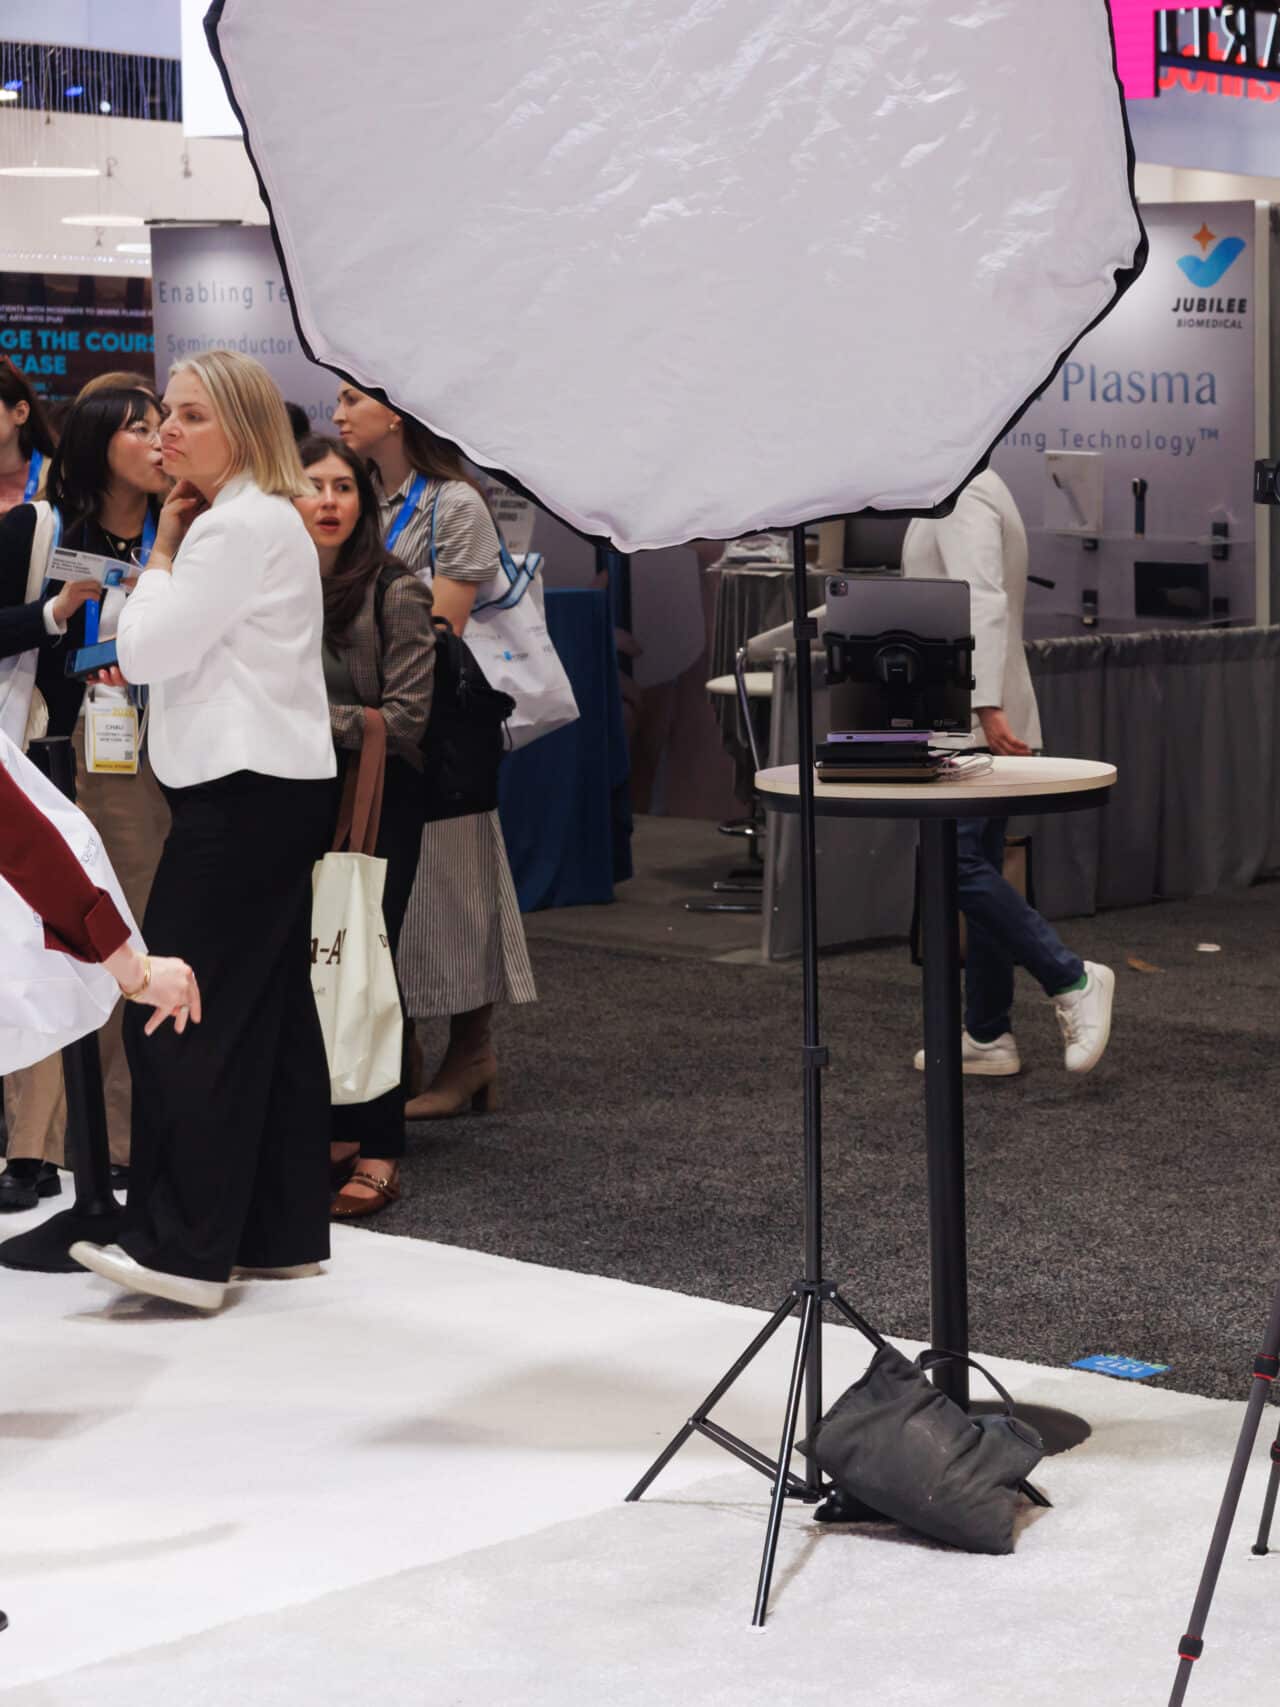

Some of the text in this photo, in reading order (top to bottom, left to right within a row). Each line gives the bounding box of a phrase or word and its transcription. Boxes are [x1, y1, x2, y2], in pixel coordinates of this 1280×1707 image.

[158, 280, 253, 309] Enabling
[1171, 297, 1247, 314] JUBILEE
[1176, 318, 1243, 329] BIOMEDICAL
[0, 328, 32, 351] GE
[37, 329, 81, 351] THE
[166, 335, 295, 354] Semiconductor
[9, 353, 67, 375] EASE
[1062, 361, 1216, 405] Plasma
